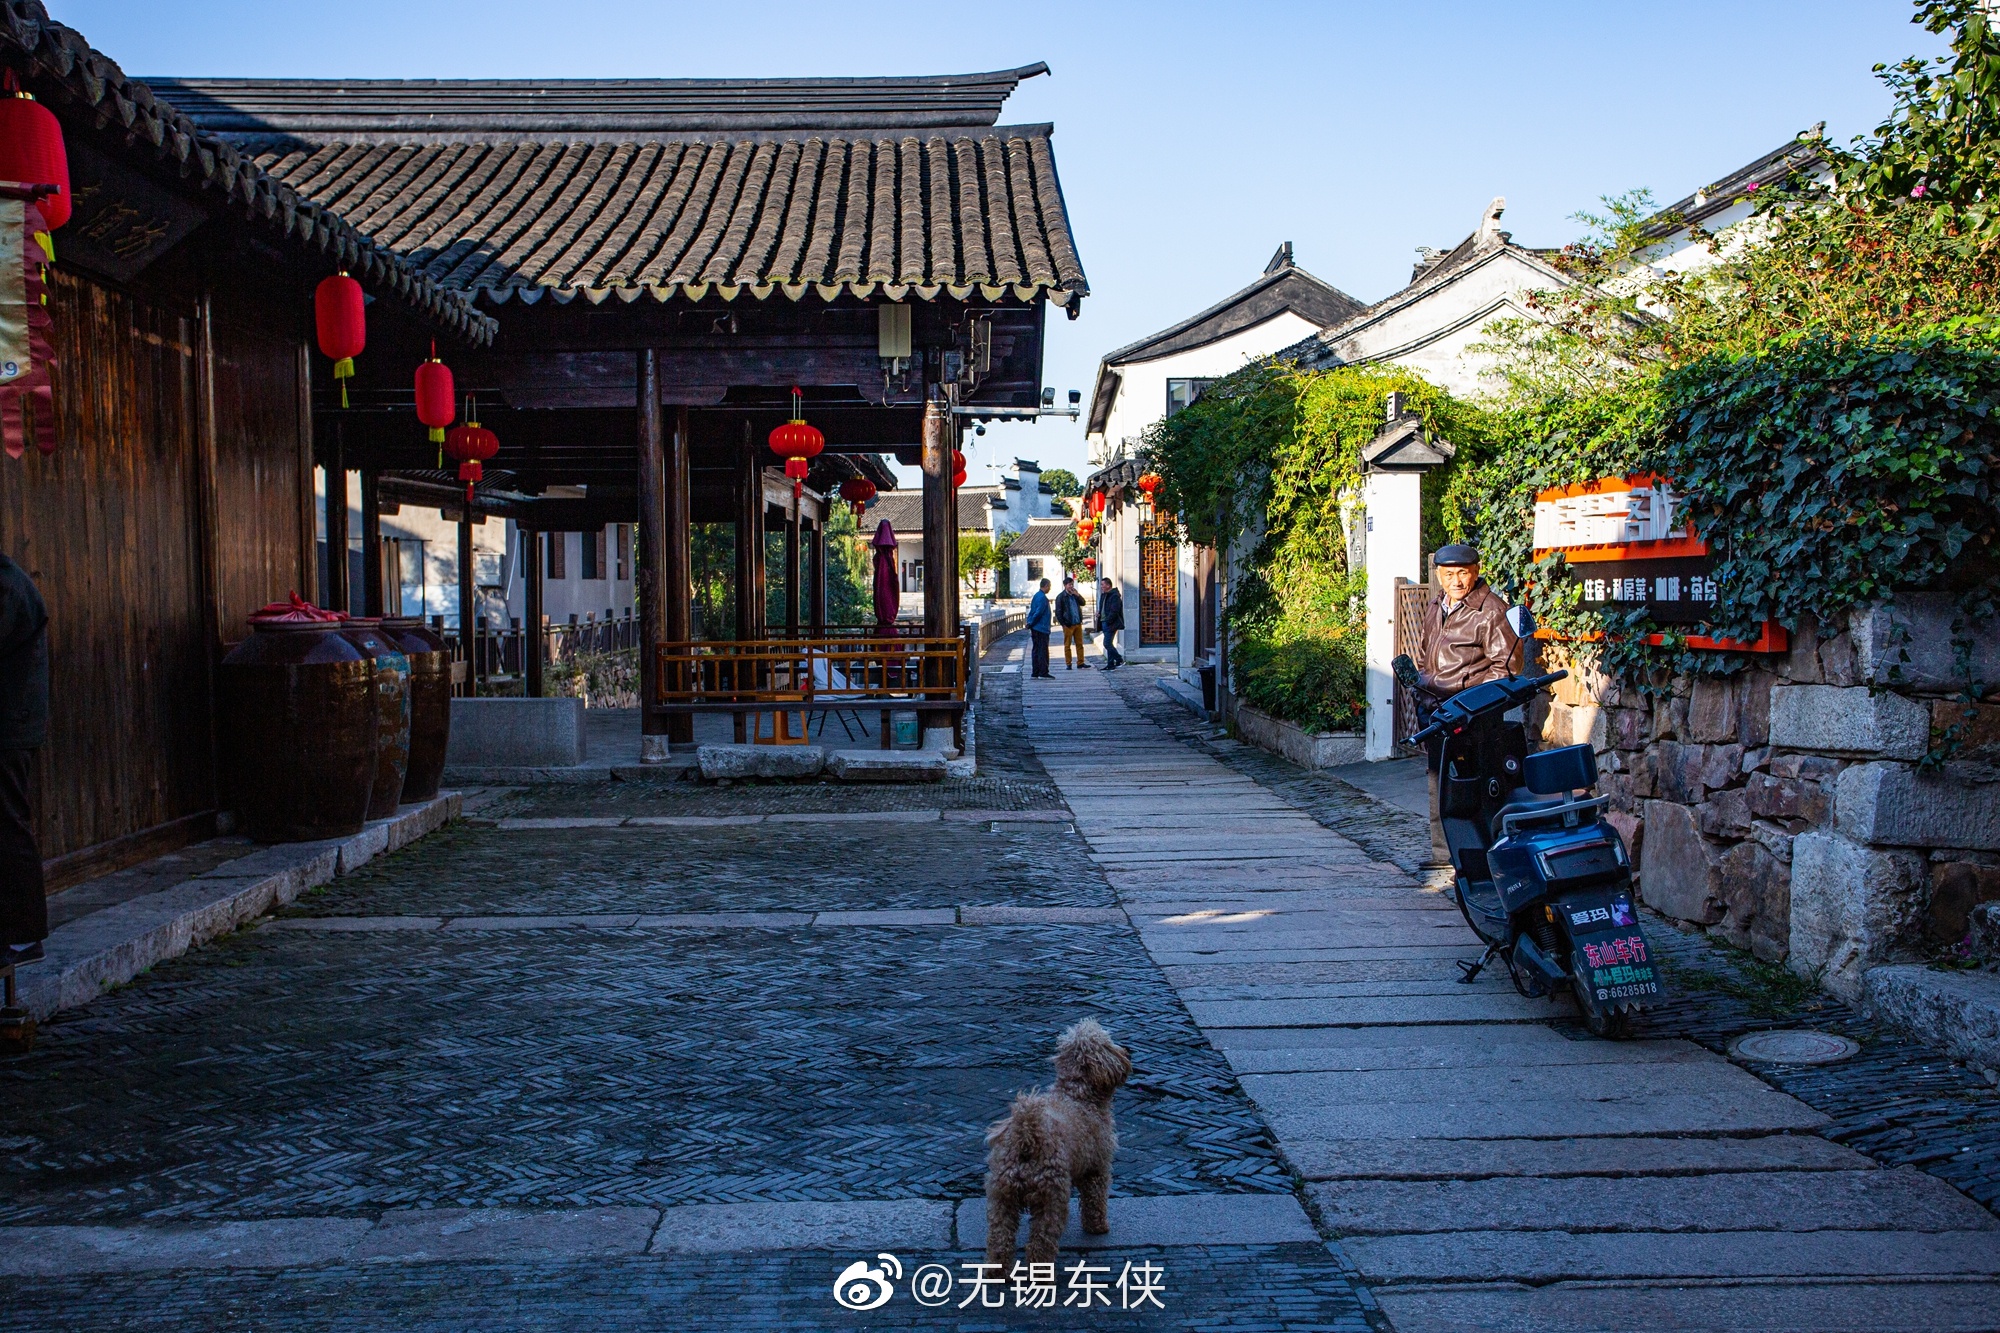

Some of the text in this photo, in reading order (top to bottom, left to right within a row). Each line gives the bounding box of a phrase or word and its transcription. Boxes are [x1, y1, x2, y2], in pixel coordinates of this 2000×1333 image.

[1570, 907, 1610, 926] 爱玛
[1583, 936, 1647, 968] 东山车行
